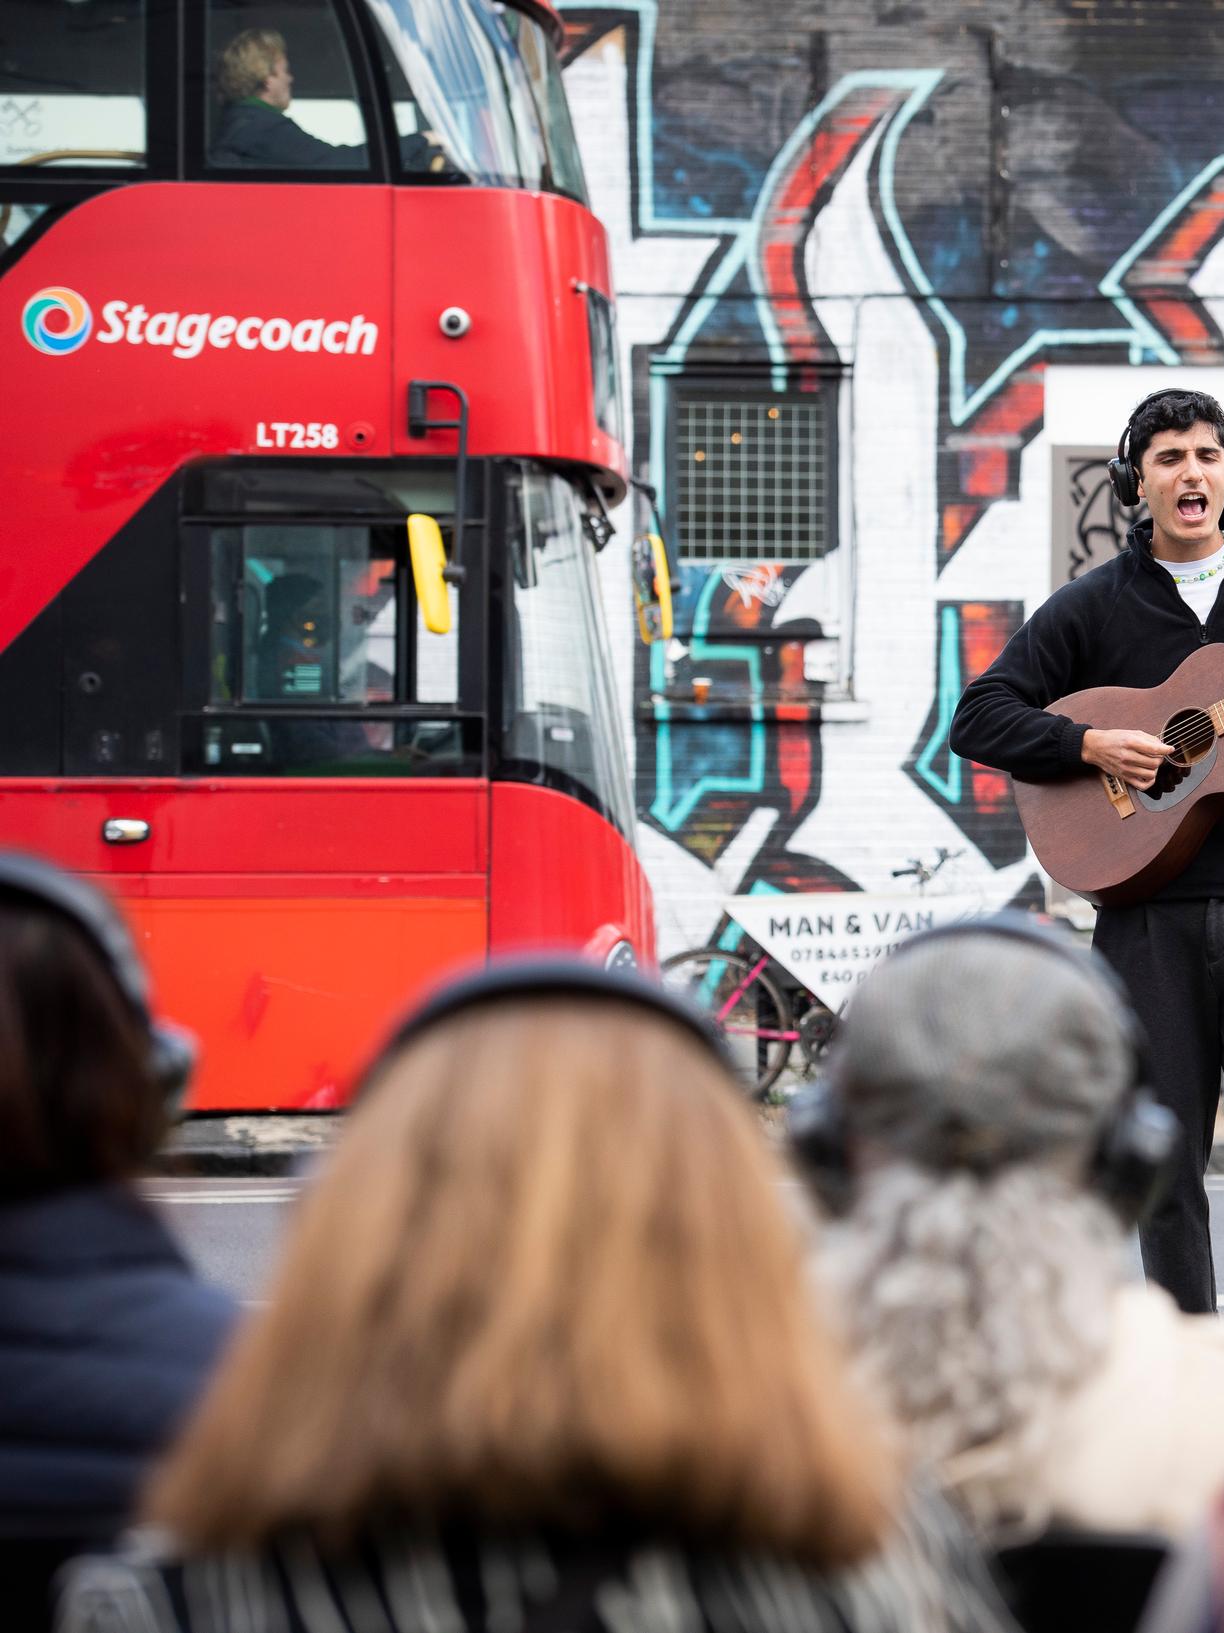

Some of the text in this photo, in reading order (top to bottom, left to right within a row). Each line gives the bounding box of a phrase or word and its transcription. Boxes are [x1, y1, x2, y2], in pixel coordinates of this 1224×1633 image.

[97, 300, 379, 359] Stagecoach
[256, 422, 339, 448] LT258
[769, 911, 933, 937] MAN & VAN
